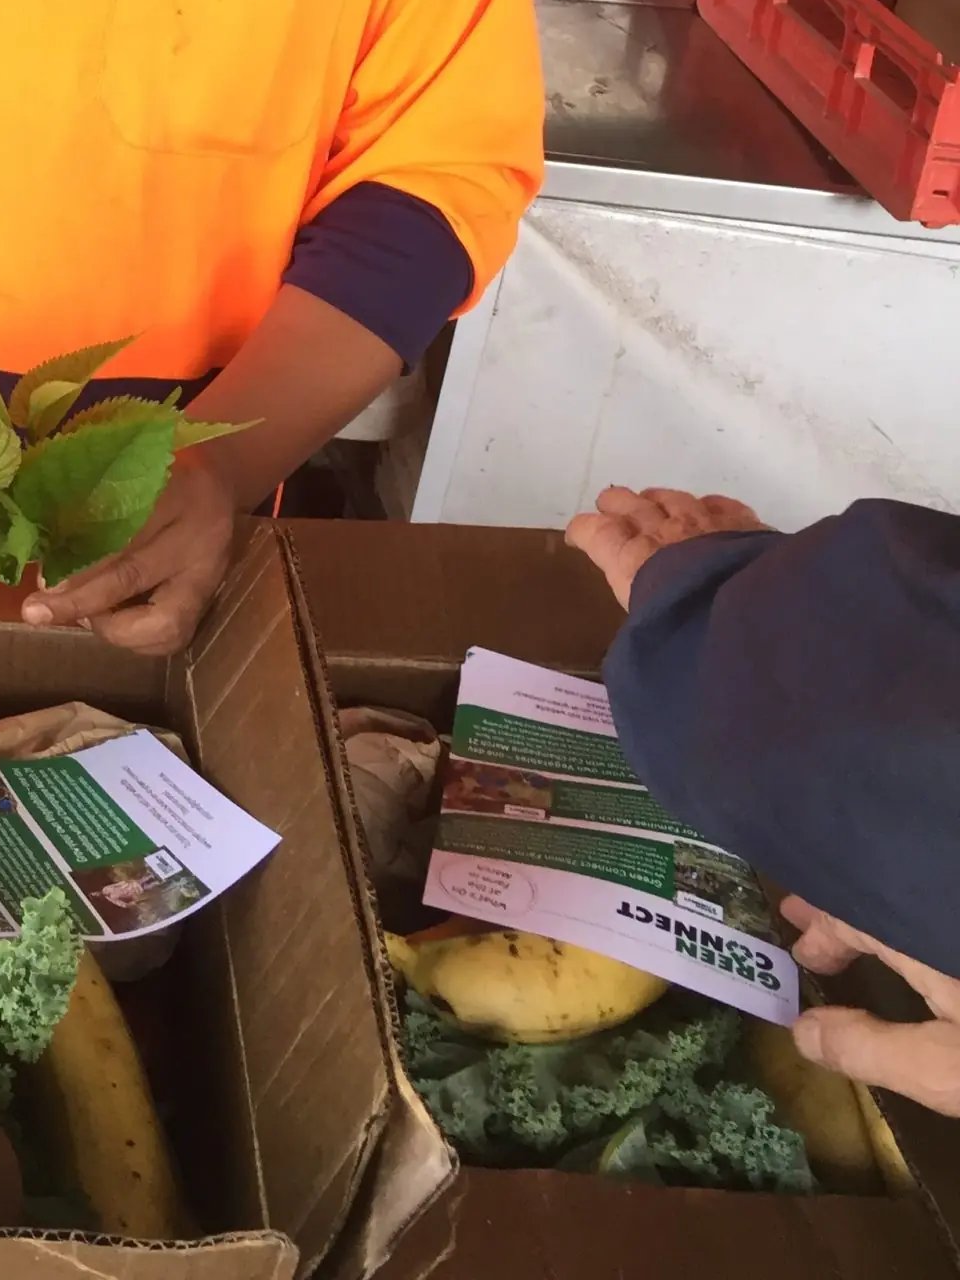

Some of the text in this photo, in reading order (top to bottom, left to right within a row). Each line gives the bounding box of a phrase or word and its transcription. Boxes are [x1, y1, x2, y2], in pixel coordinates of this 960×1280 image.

[481, 740, 509, 752] March
[512, 746, 567, 762] Champagne
[515, 755, 574, 770] Vegetables
[599, 816, 632, 826] March
[636, 821, 679, 833] Families
[682, 828, 698, 837] for
[580, 860, 627, 877] Connect
[629, 872, 662, 888] Green
[675, 937, 781, 991] GREEN
